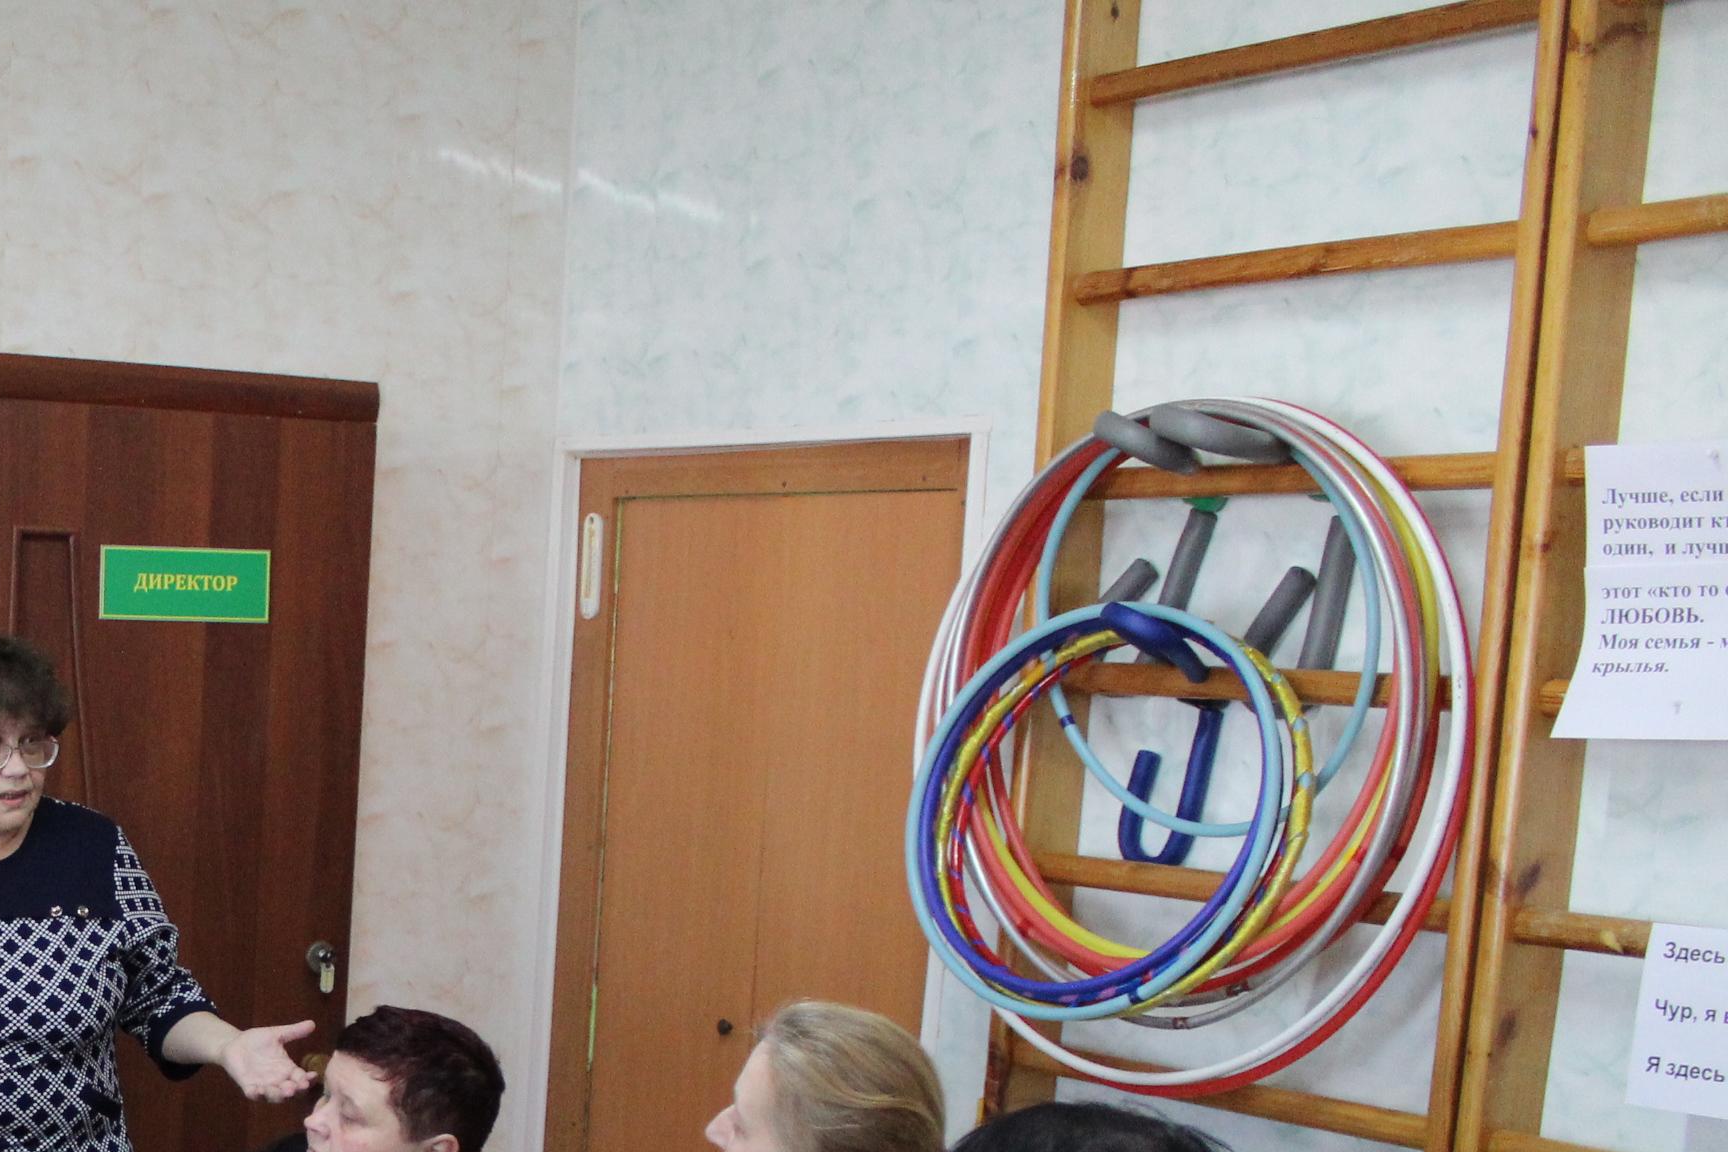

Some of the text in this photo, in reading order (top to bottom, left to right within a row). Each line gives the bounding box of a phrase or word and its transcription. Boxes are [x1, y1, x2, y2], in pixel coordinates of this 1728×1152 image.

[1602, 488, 1724, 508] Лучше, если
[1603, 516, 1705, 534] руководит
[1603, 543, 1654, 557] один,
[1665, 543, 1676, 555] и
[133, 573, 238, 593] ДИРЕКТОР
[1601, 586, 1642, 599] этот
[1647, 586, 1692, 598] «кто
[1698, 585, 1719, 598] то
[1601, 607, 1705, 625] ЛЮБОВЬ.
[1598, 633, 1639, 650] Моя
[1644, 637, 1700, 650] семья
[1592, 662, 1669, 678] крылья.
[1663, 941, 1726, 964] Здесь
[1655, 998, 1698, 1024] Чур,
[1704, 1009, 1717, 1022] я
[1646, 1056, 1725, 1083] Я здесь
